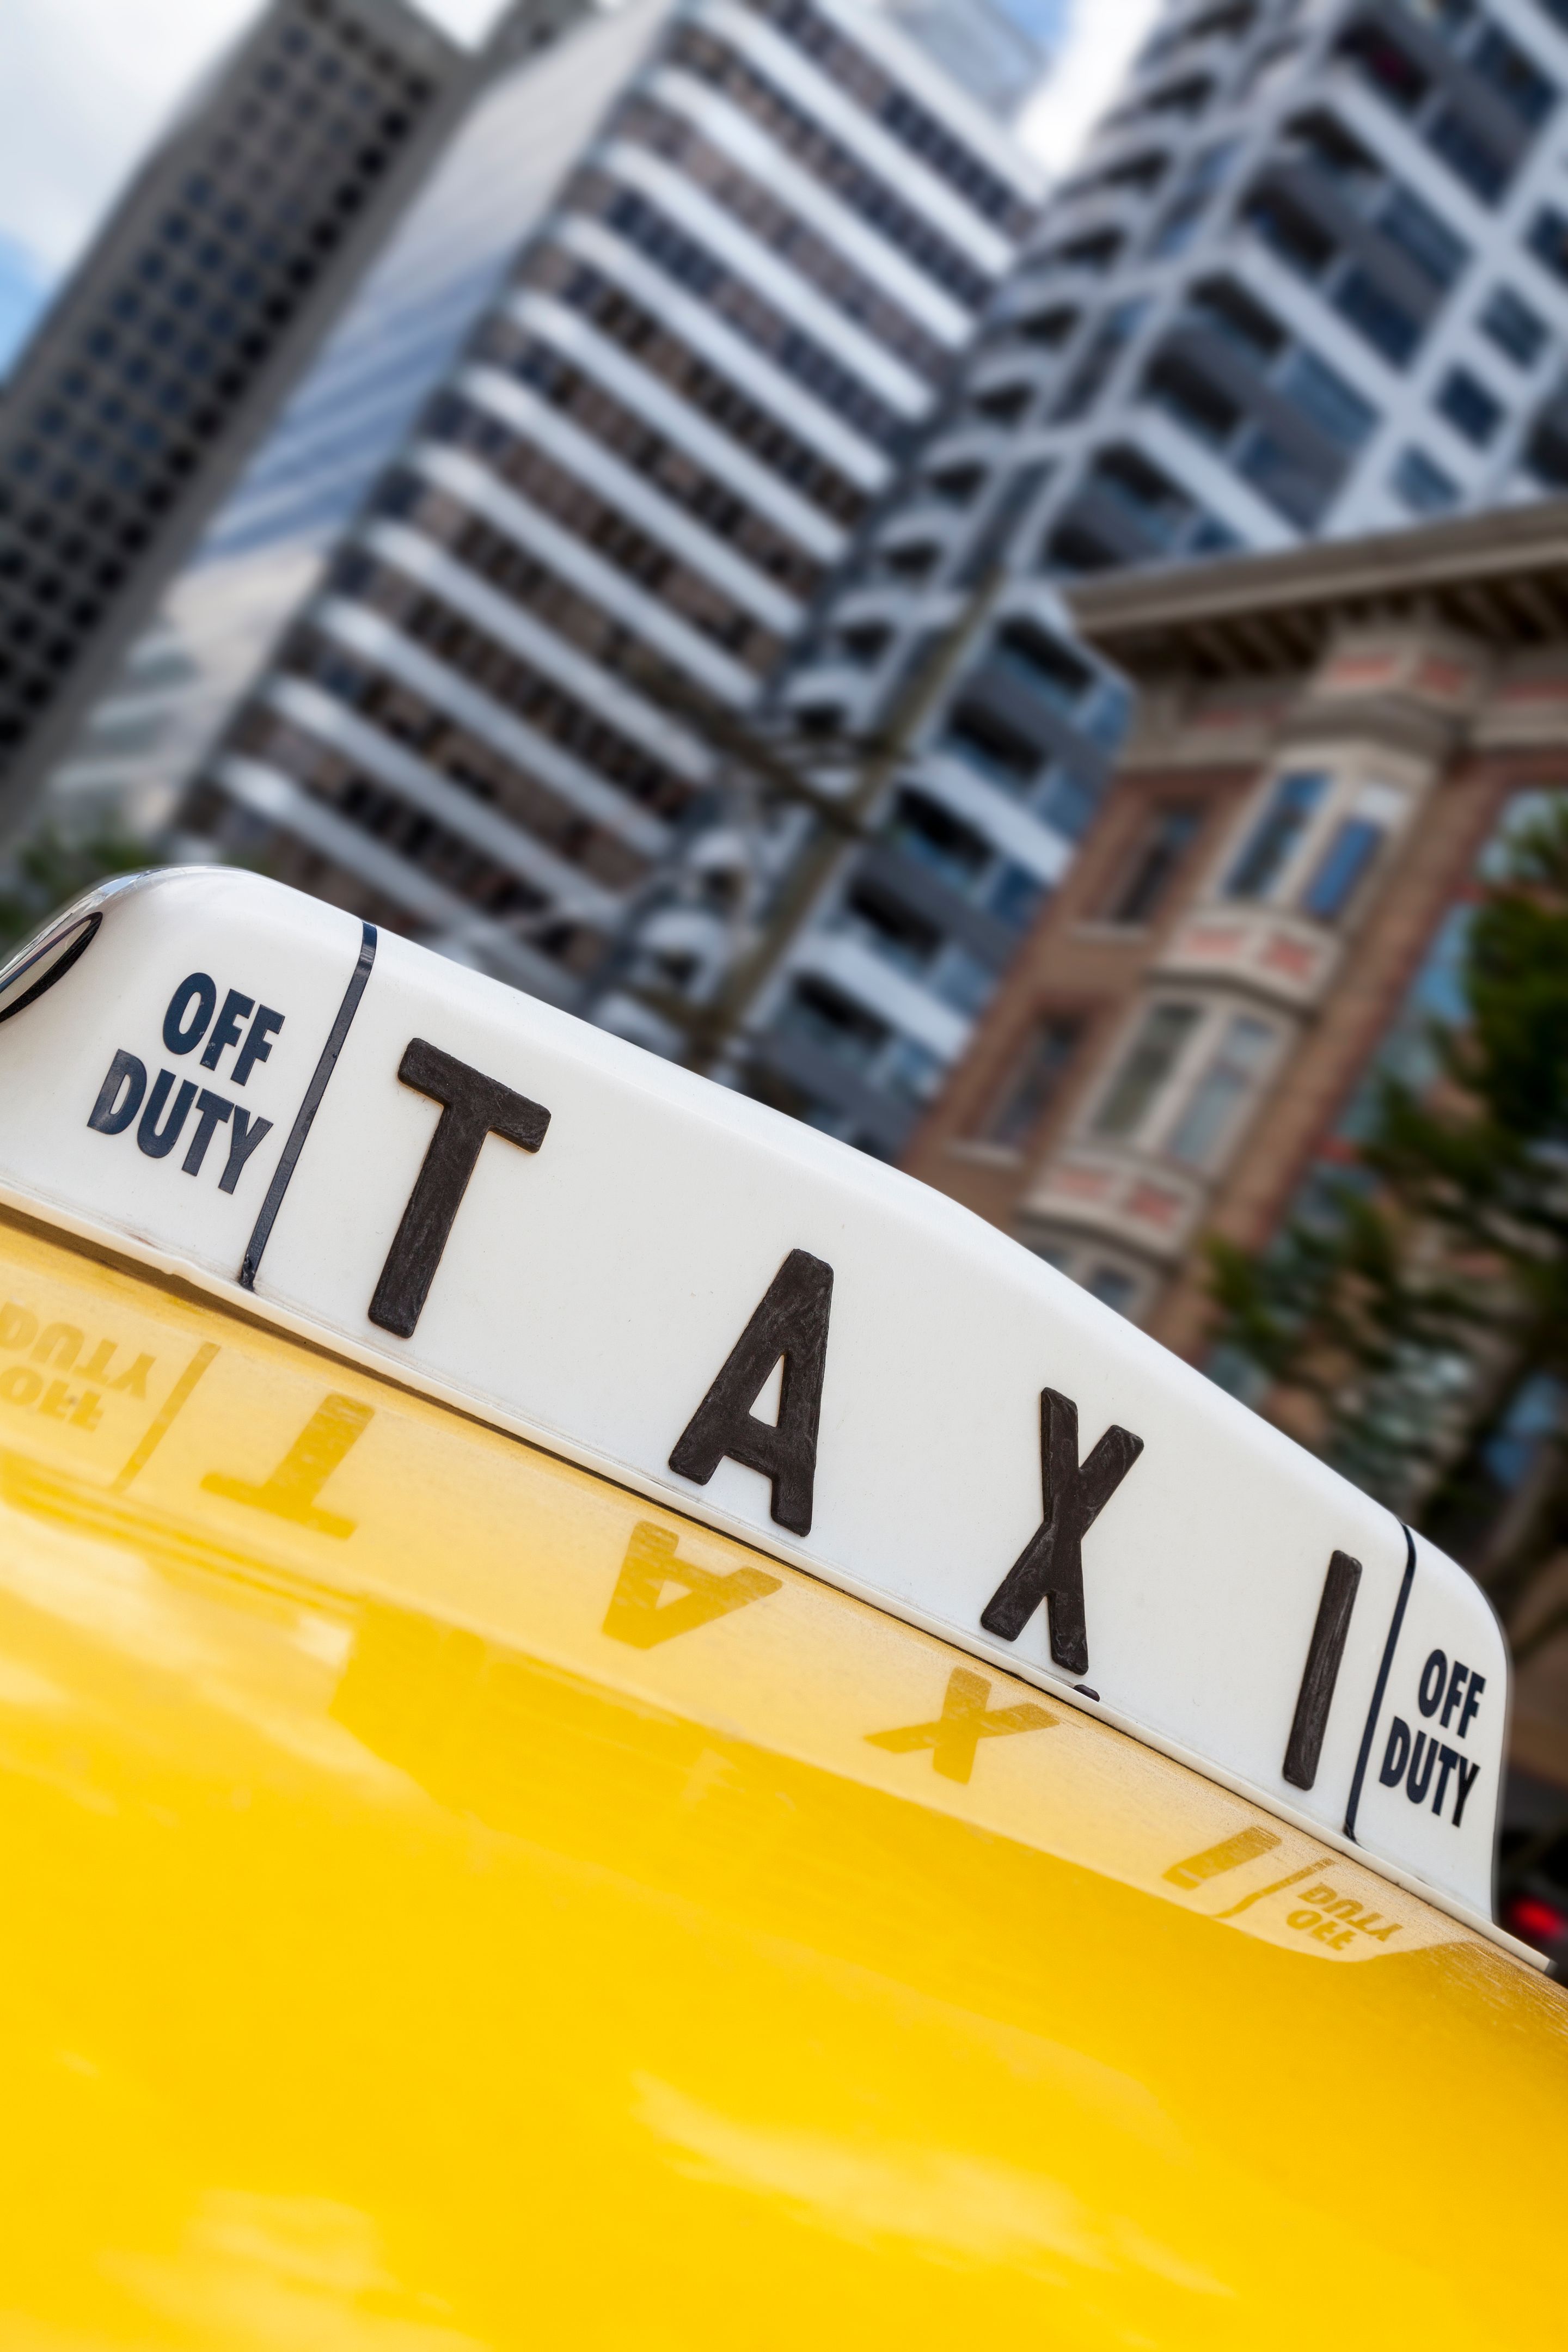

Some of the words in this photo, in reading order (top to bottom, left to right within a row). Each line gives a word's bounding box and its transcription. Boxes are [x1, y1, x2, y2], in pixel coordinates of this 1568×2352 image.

[163, 972, 285, 1086] OFF
[87, 1049, 273, 1195] DUTY
[369, 1038, 1362, 1790] TAXI
[1418, 1649, 1486, 1738] OFF
[1379, 1716, 1480, 1827] DUTY
